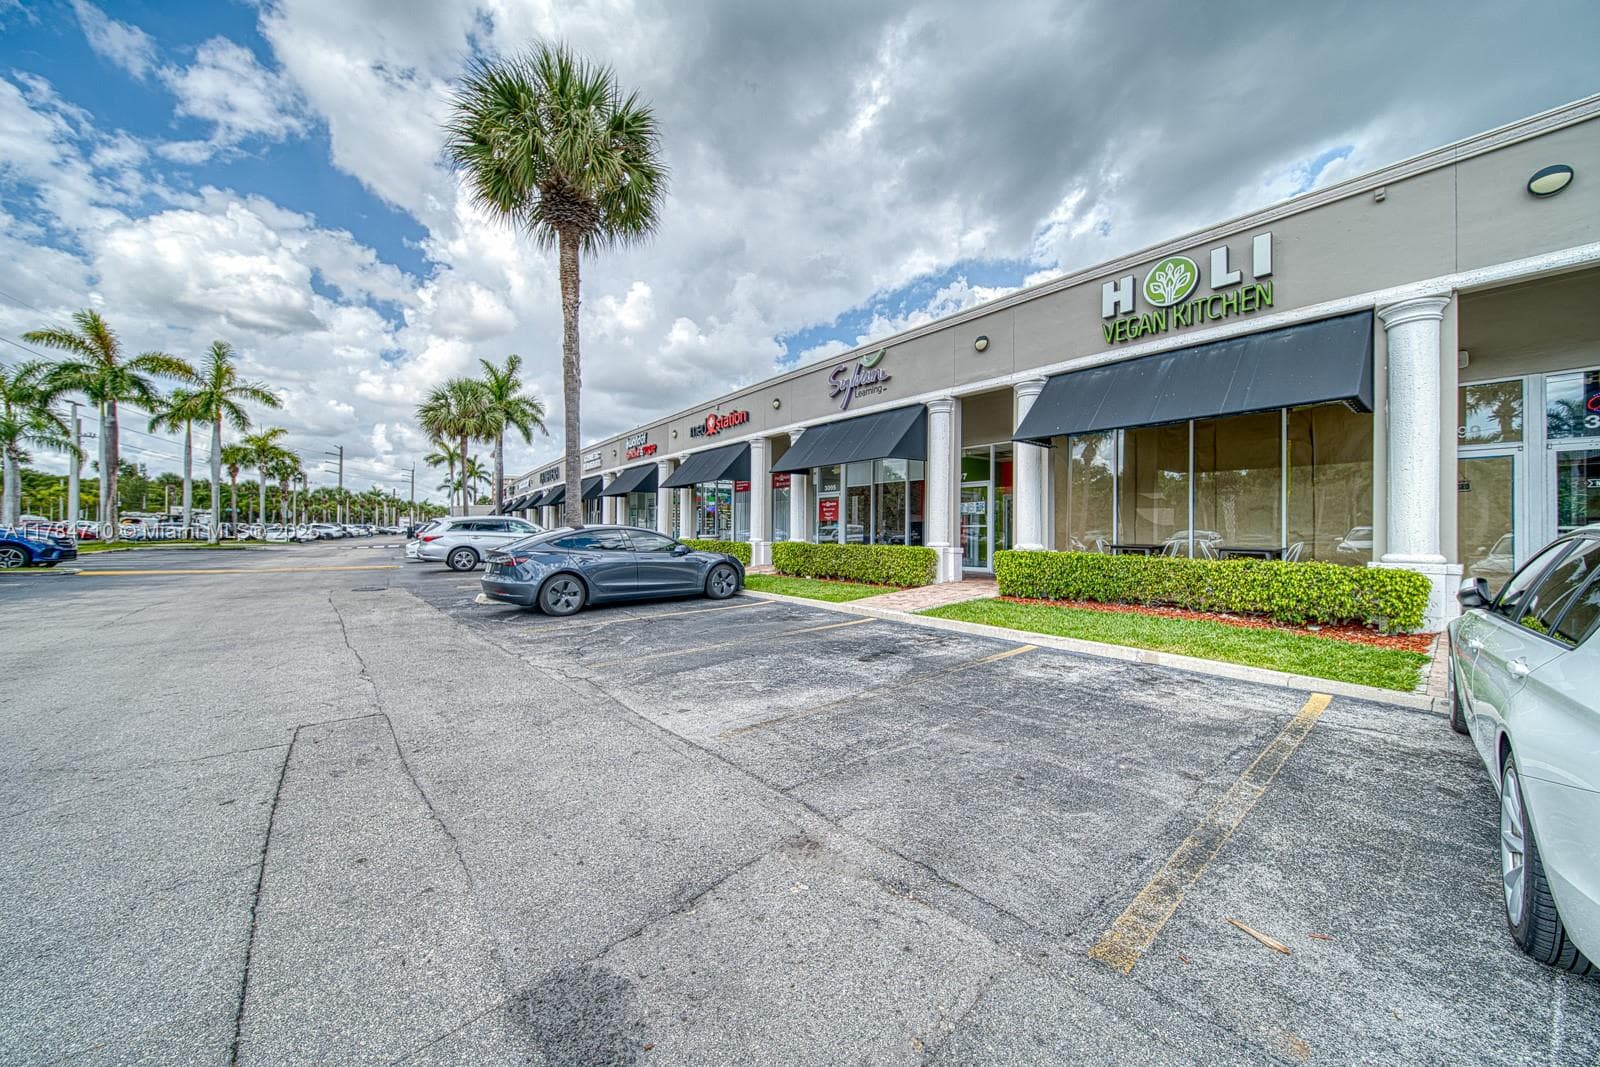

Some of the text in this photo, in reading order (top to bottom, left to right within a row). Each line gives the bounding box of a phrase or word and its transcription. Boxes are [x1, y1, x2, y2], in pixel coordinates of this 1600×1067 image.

[1102, 280, 1274, 344] VEGAN KITCHEN
[854, 385, 883, 398] Learning
